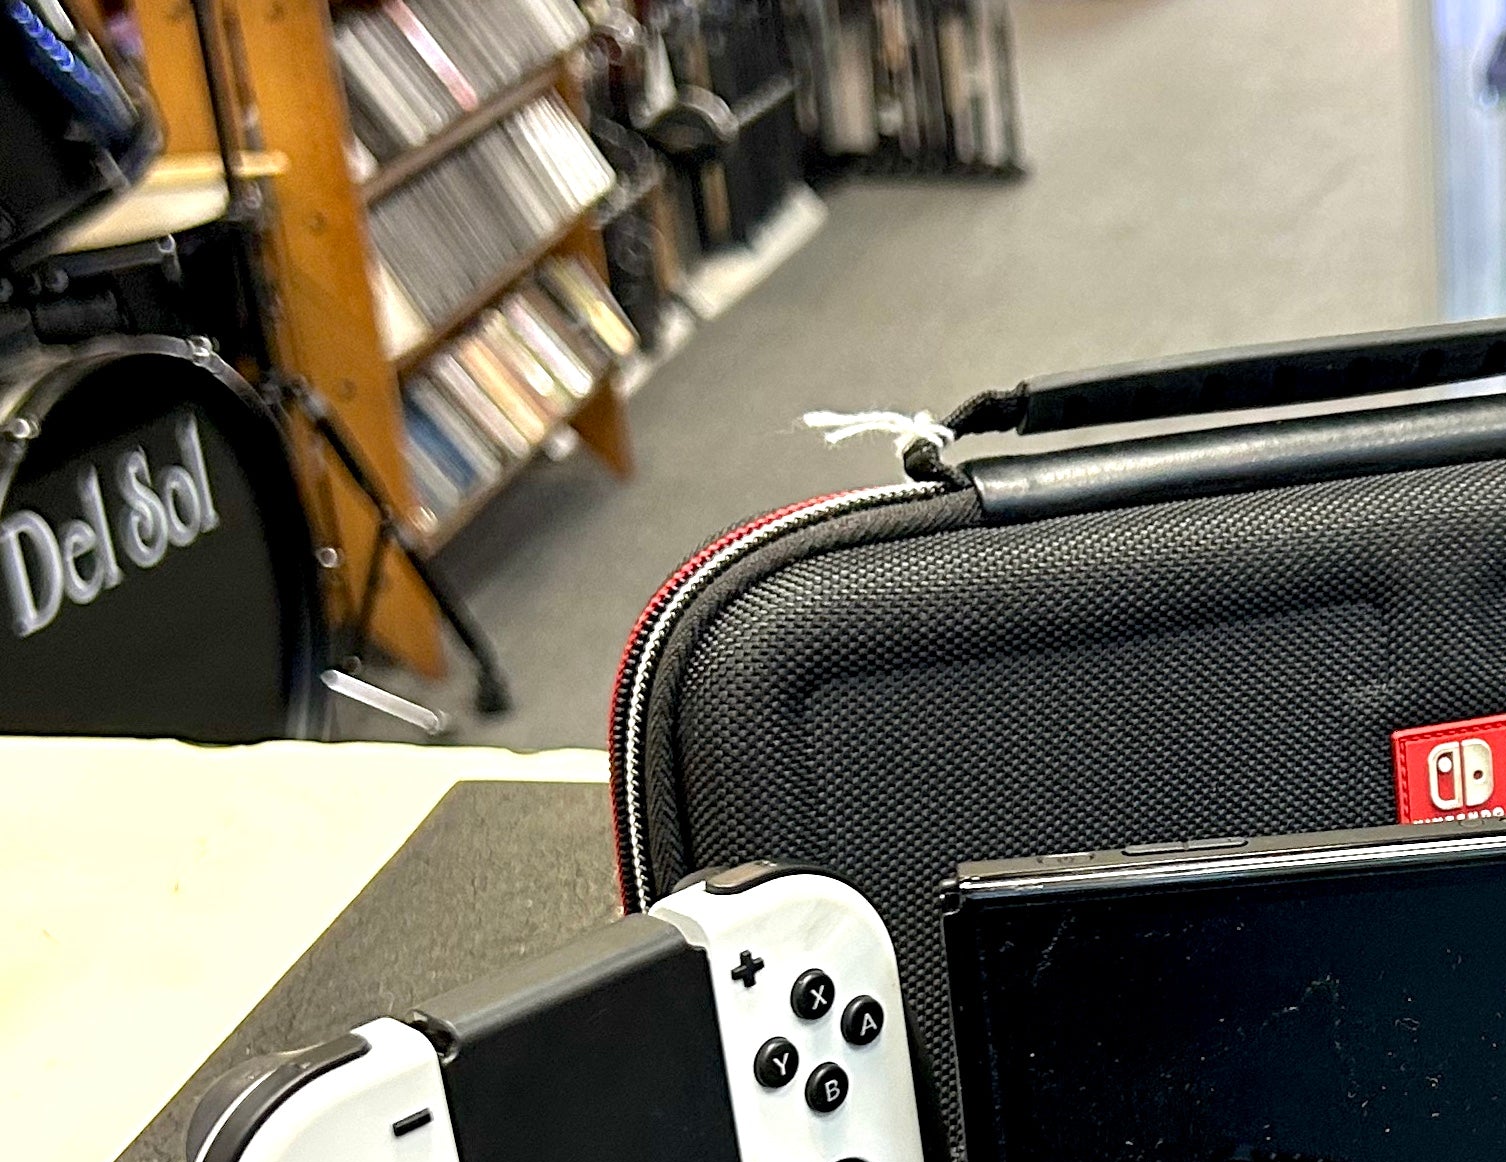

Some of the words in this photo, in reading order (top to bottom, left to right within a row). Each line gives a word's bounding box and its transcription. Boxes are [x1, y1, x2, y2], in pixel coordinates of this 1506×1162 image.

[0, 463, 124, 637] Del
[117, 410, 219, 568] Sol
[810, 984, 828, 1010] X
[859, 1012, 878, 1037] A
[772, 1052, 790, 1076] Y
[824, 1079, 841, 1103] B
